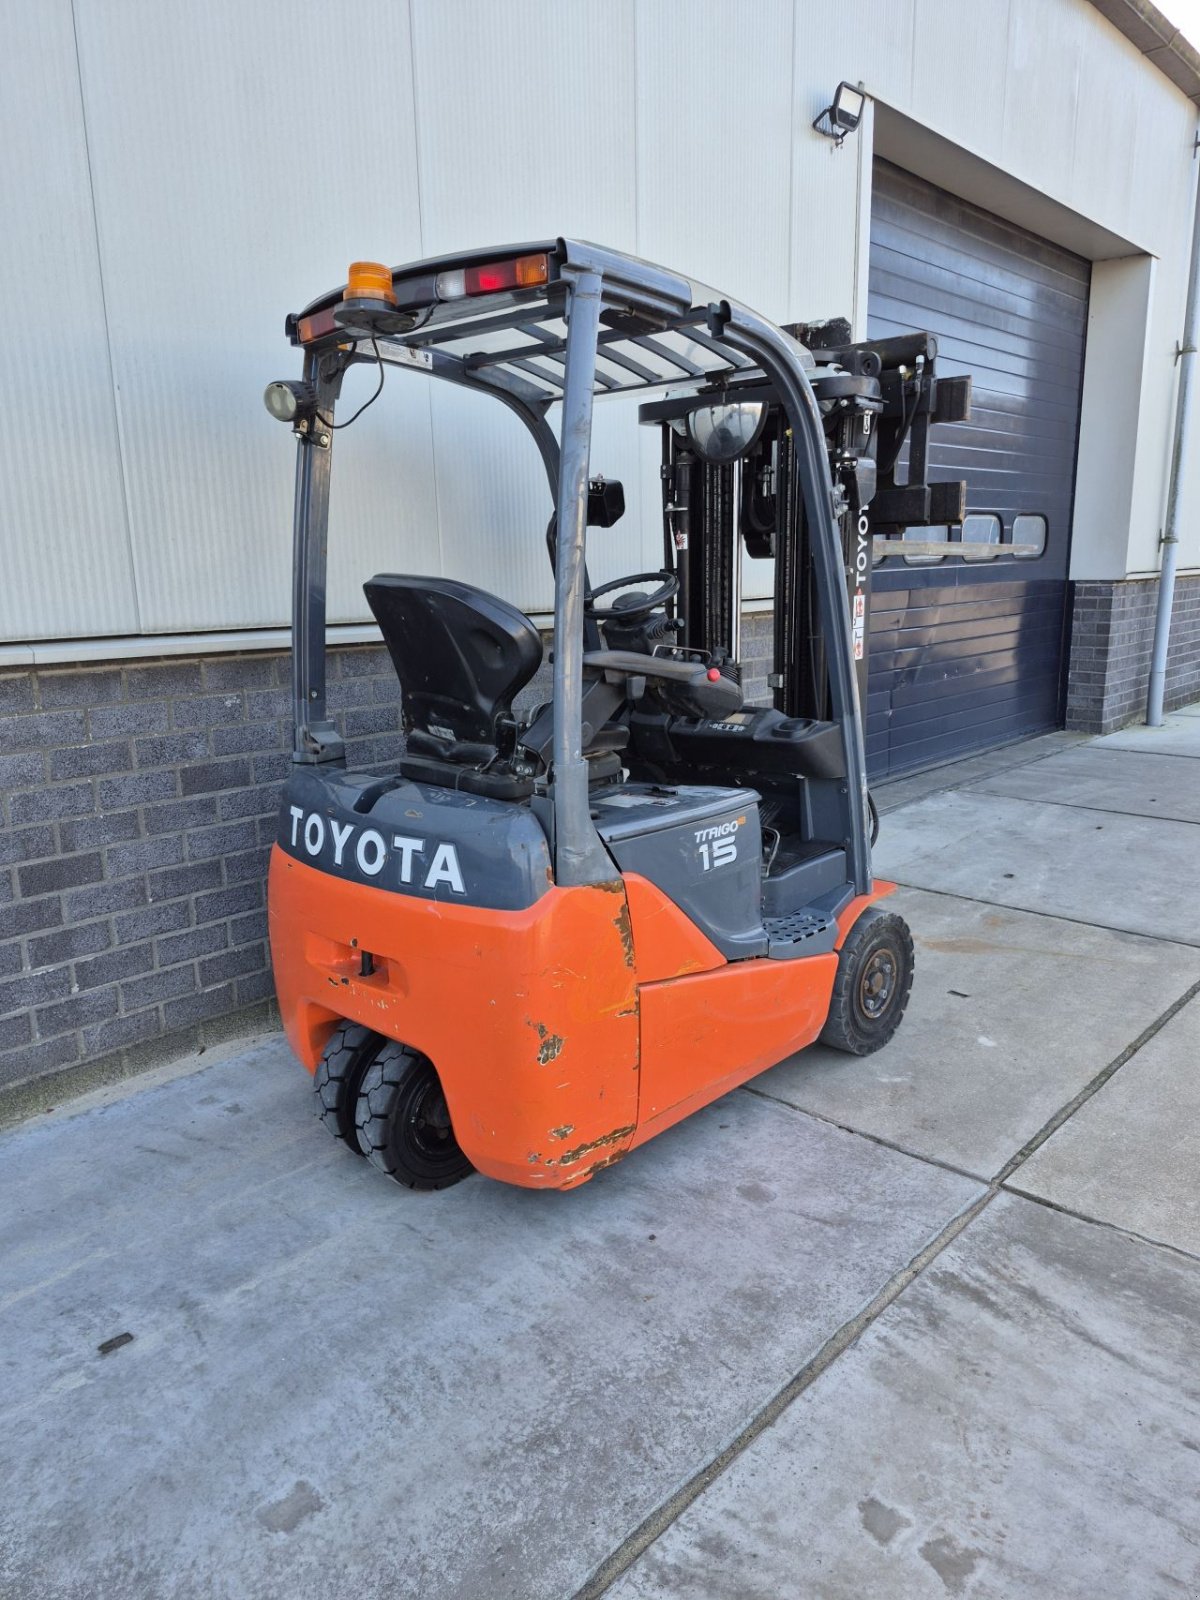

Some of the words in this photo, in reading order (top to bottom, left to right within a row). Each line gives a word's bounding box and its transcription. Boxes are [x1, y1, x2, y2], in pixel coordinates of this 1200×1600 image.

[856, 505, 869, 587] TOYOT
[290, 805, 466, 894] TOYOTA
[698, 835, 738, 871] 15
